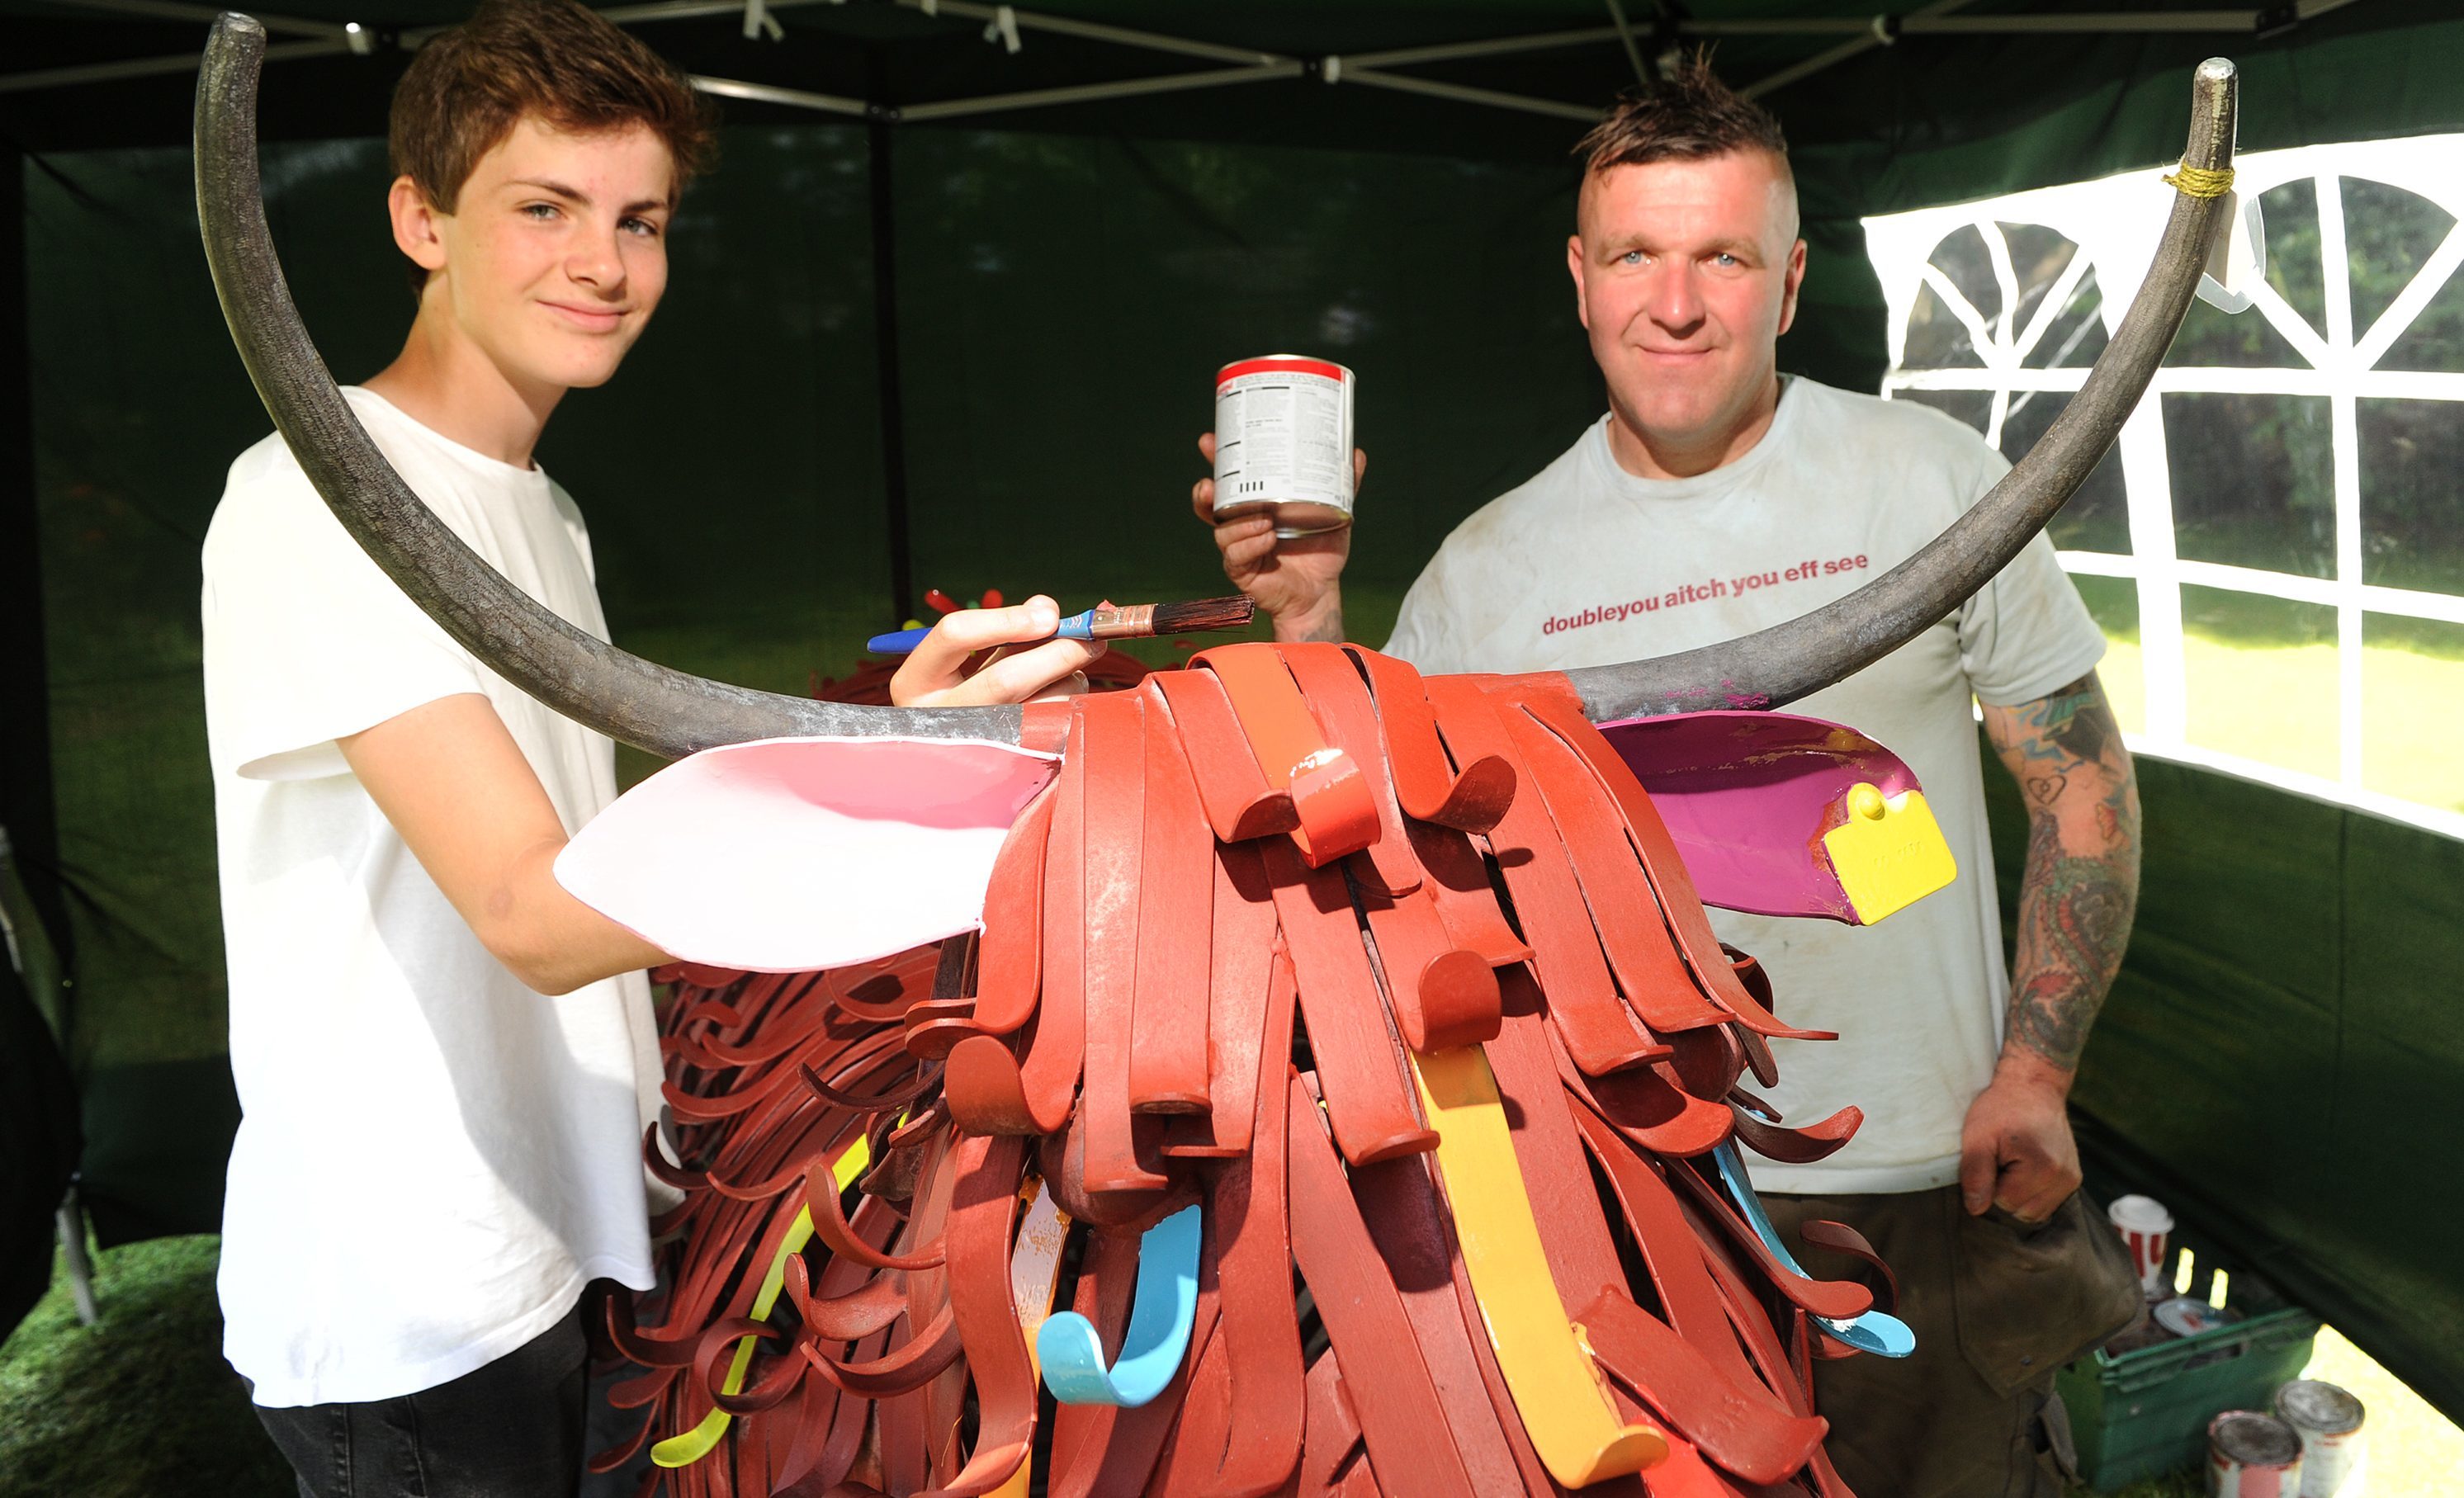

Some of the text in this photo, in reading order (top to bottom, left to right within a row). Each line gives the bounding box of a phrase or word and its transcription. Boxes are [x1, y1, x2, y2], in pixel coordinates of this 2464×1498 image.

[1543, 554, 1868, 635] doubleyou aitch you eff see
